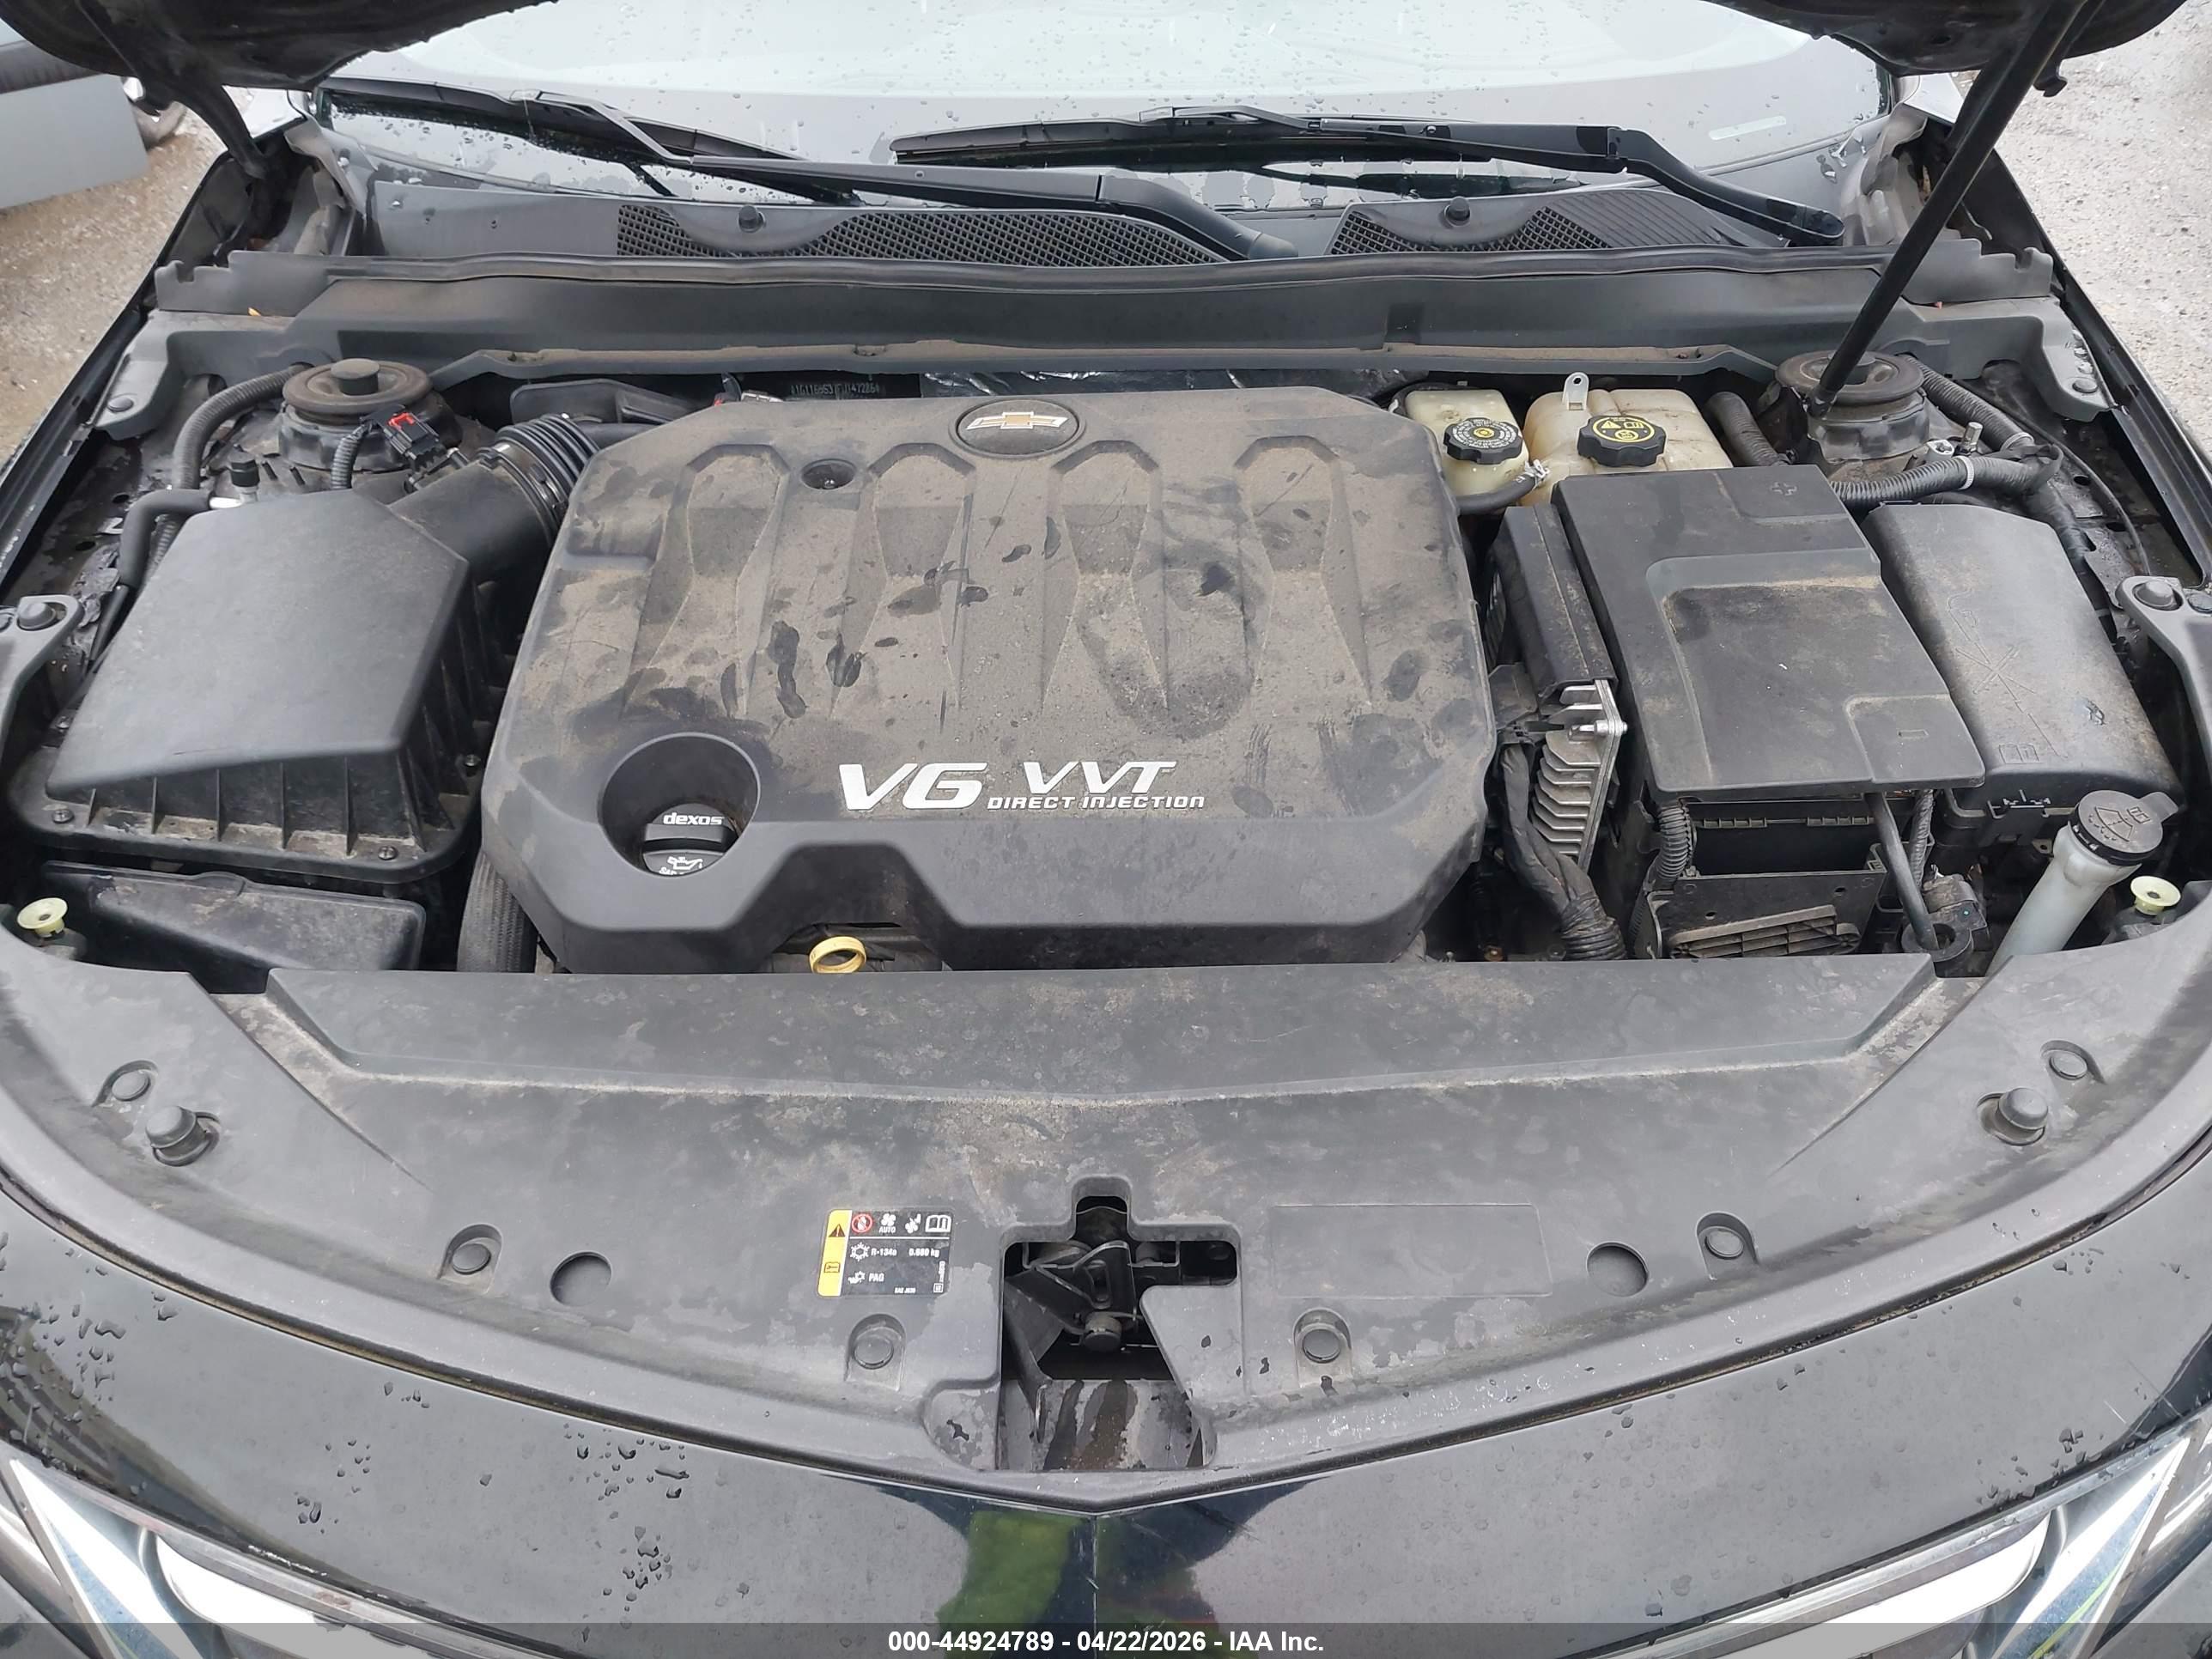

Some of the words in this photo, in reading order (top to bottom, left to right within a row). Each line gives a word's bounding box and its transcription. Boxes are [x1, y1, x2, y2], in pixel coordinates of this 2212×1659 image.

[839, 762, 988, 811] V6
[1023, 761, 1177, 794] VVT
[987, 795, 1075, 810] DIRECT
[1082, 795, 1204, 810] INJECTION
[663, 812, 725, 825] dexos
